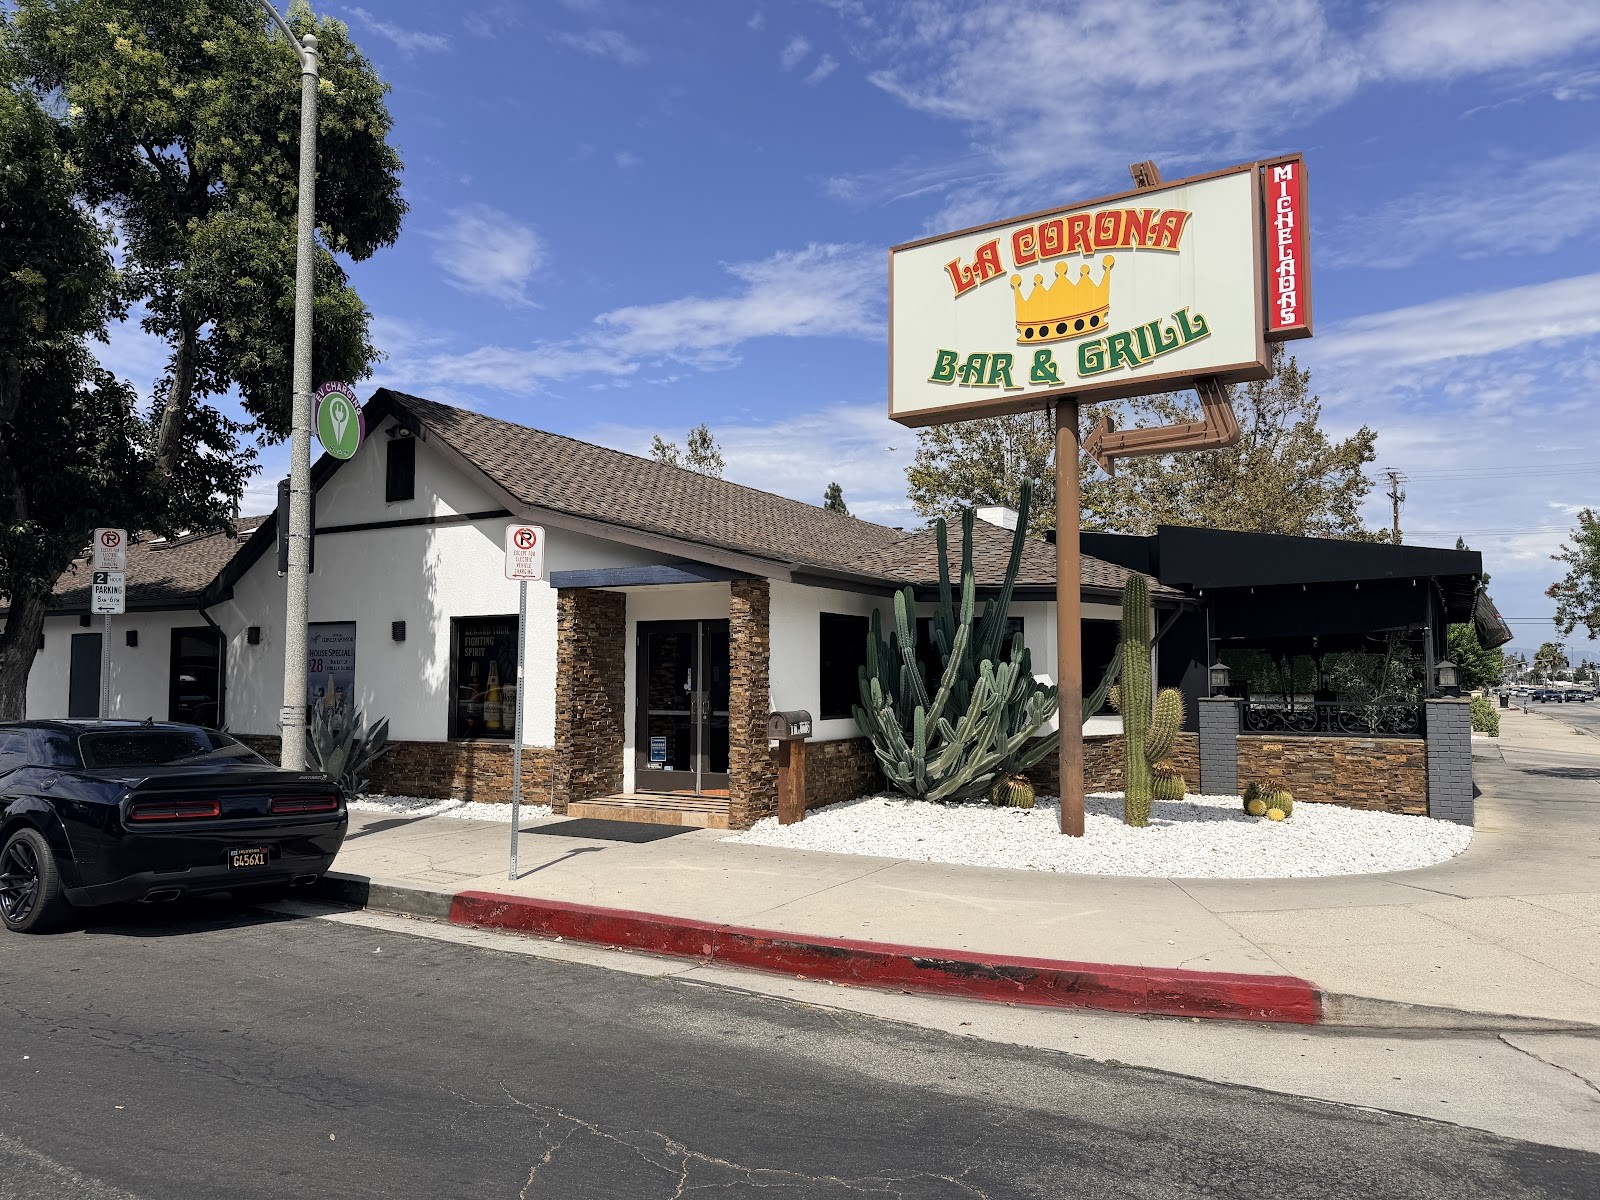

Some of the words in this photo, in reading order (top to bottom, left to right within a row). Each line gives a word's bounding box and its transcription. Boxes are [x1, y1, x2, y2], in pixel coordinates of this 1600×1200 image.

[1272, 164, 1297, 326] MICHELADAS
[944, 237, 1007, 299] LA
[1011, 207, 1193, 267] CORONA
[927, 348, 1025, 390] BAR
[1029, 348, 1065, 386] &
[1076, 306, 1213, 376] GRILL
[315, 388, 325, 402] EV
[325, 381, 363, 416] CHARGING
[96, 573, 105, 583] 2
[95, 585, 123, 595] PARKING
[492, 624, 510, 635] YOUR
[464, 636, 495, 647] FIGHTING
[464, 648, 485, 656] SPIRIT
[234, 854, 264, 866] G456X1
